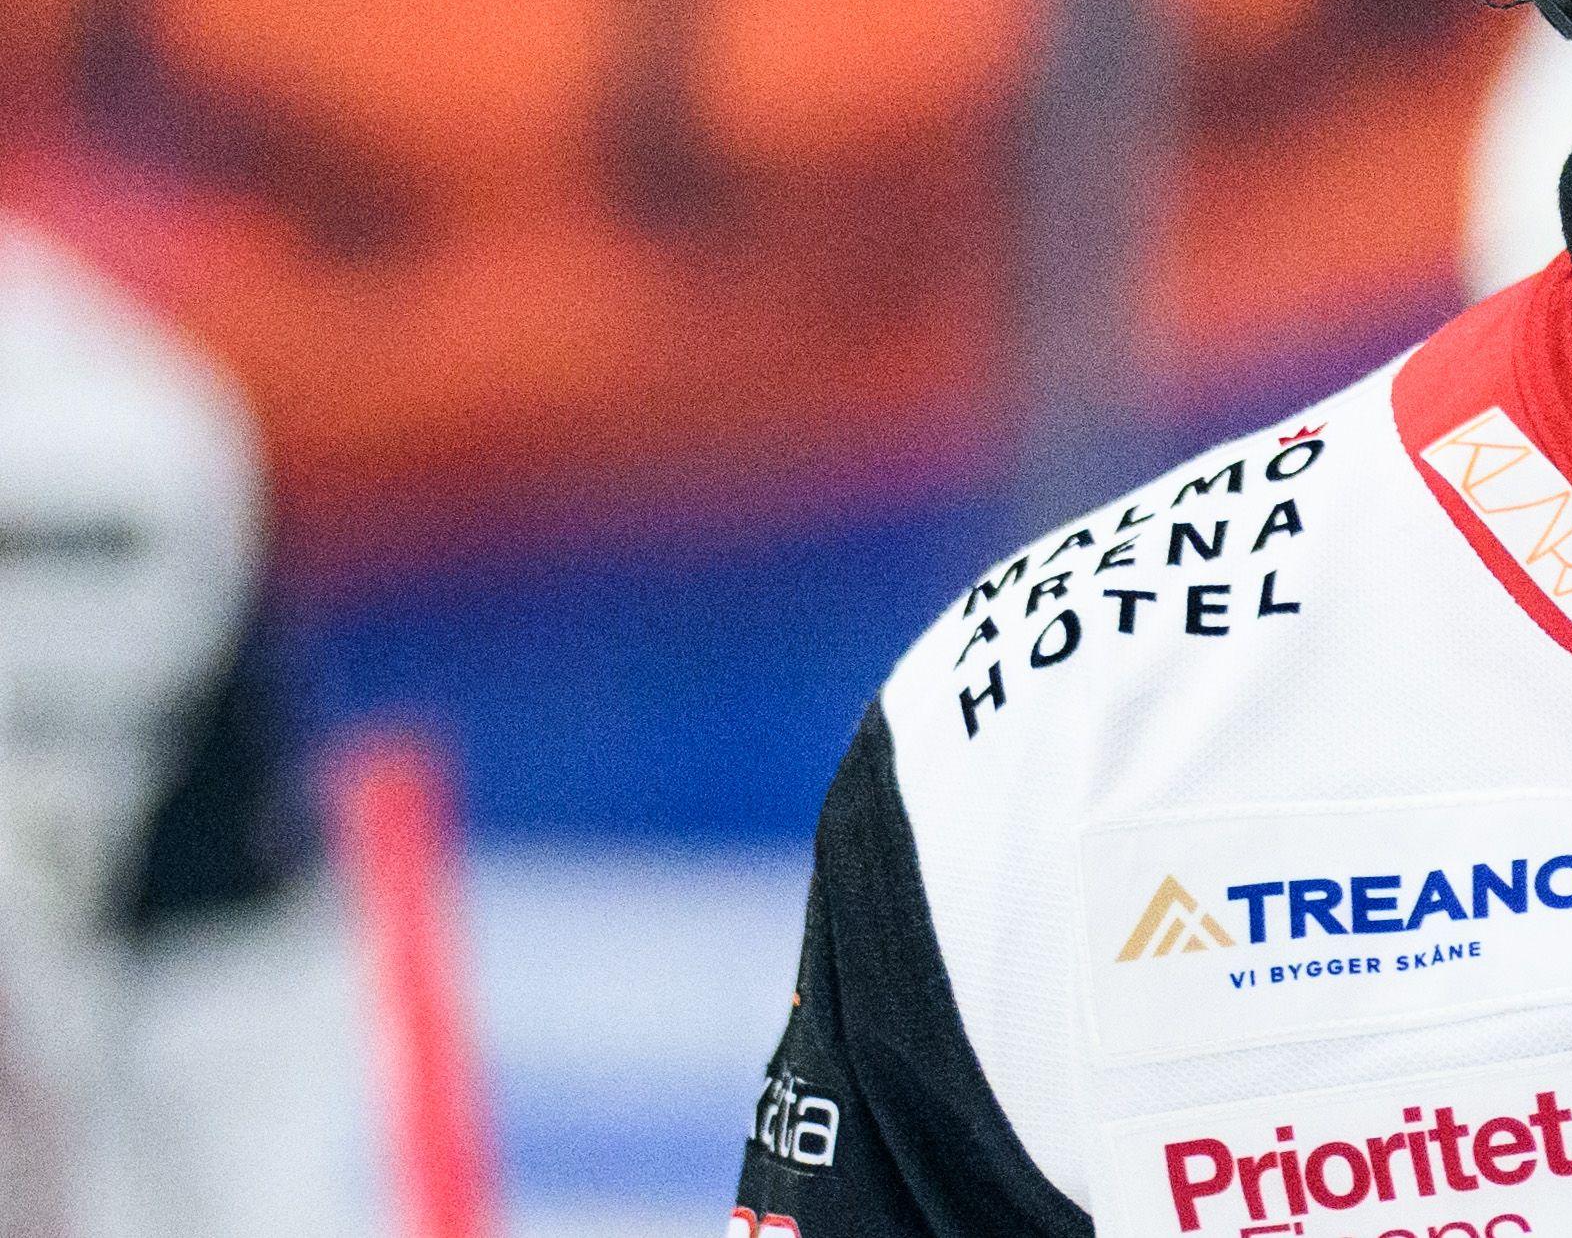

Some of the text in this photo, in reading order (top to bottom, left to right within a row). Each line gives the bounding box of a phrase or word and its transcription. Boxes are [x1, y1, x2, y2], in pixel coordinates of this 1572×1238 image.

[954, 498, 1305, 670] ARENA
[958, 569, 1301, 740] HOTEL
[1229, 940, 1483, 990] VI BYGGER SKÅNE
